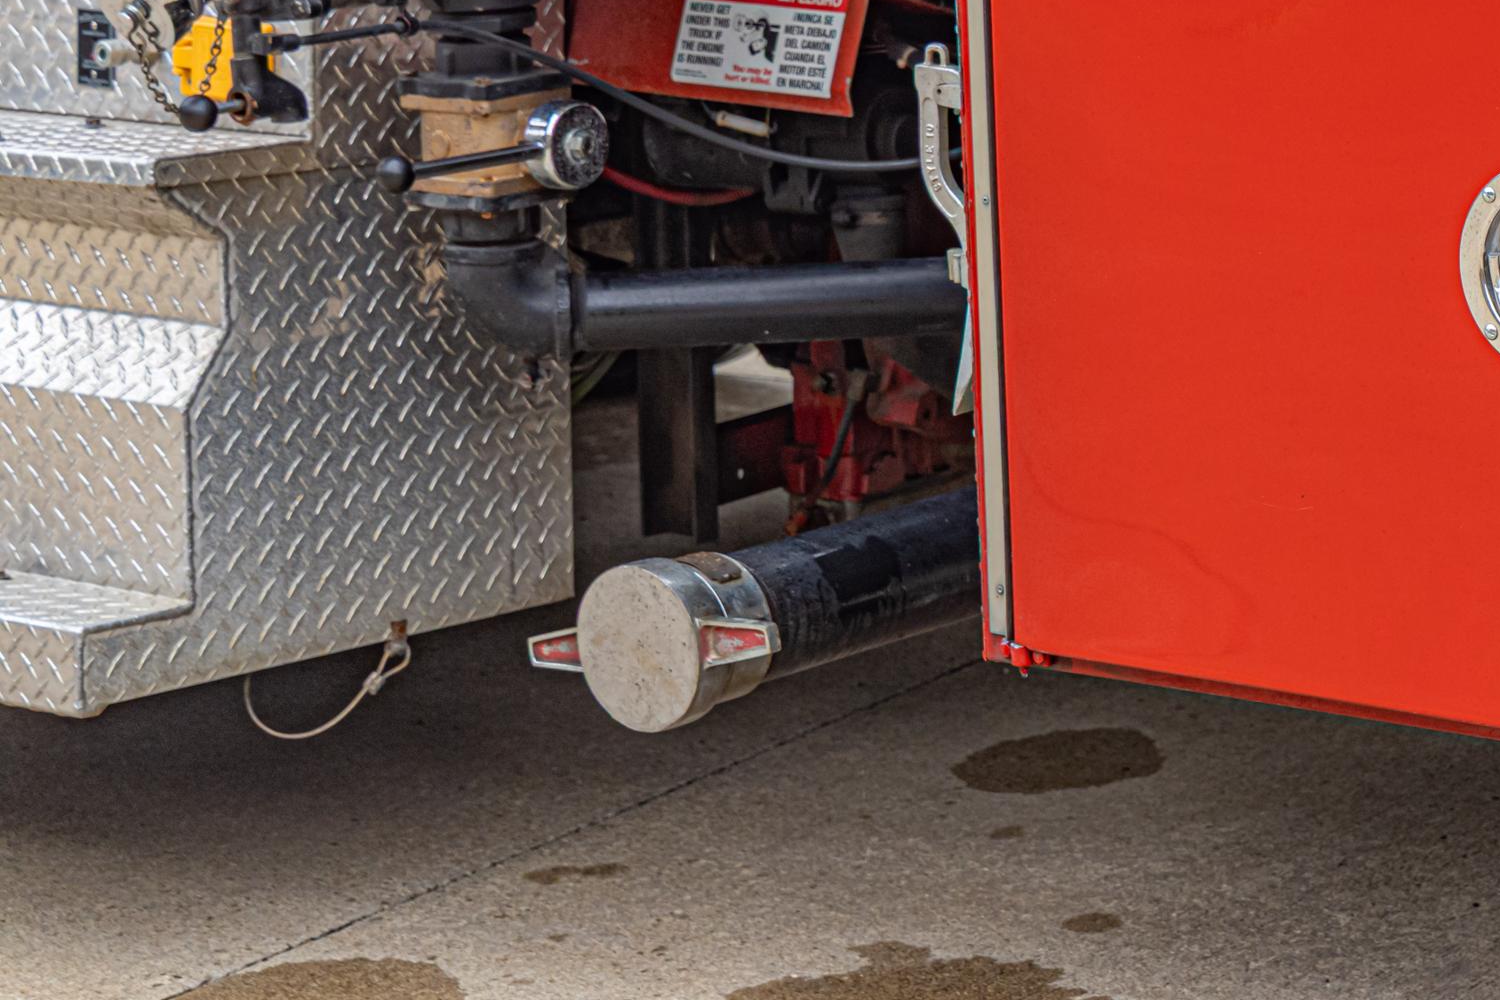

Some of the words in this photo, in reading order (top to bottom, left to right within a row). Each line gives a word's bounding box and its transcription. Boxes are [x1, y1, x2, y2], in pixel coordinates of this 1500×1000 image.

[690, 2, 715, 13] NEVER
[716, 4, 731, 14] GET
[686, 14, 711, 26] UNDER
[713, 16, 730, 28] THIS
[824, 15, 834, 25] SE
[689, 27, 713, 39] TRUCK
[715, 30, 722, 40] IF
[785, 25, 804, 36] META
[806, 26, 837, 39] DEBAJO
[682, 40, 695, 51] THE
[697, 42, 725, 54] ENGINE
[785, 38, 798, 48] DEL
[677, 53, 685, 63] IS
[817, 55, 825, 65] EL
[779, 64, 806, 75] MOTOR
[776, 77, 786, 87] EN
